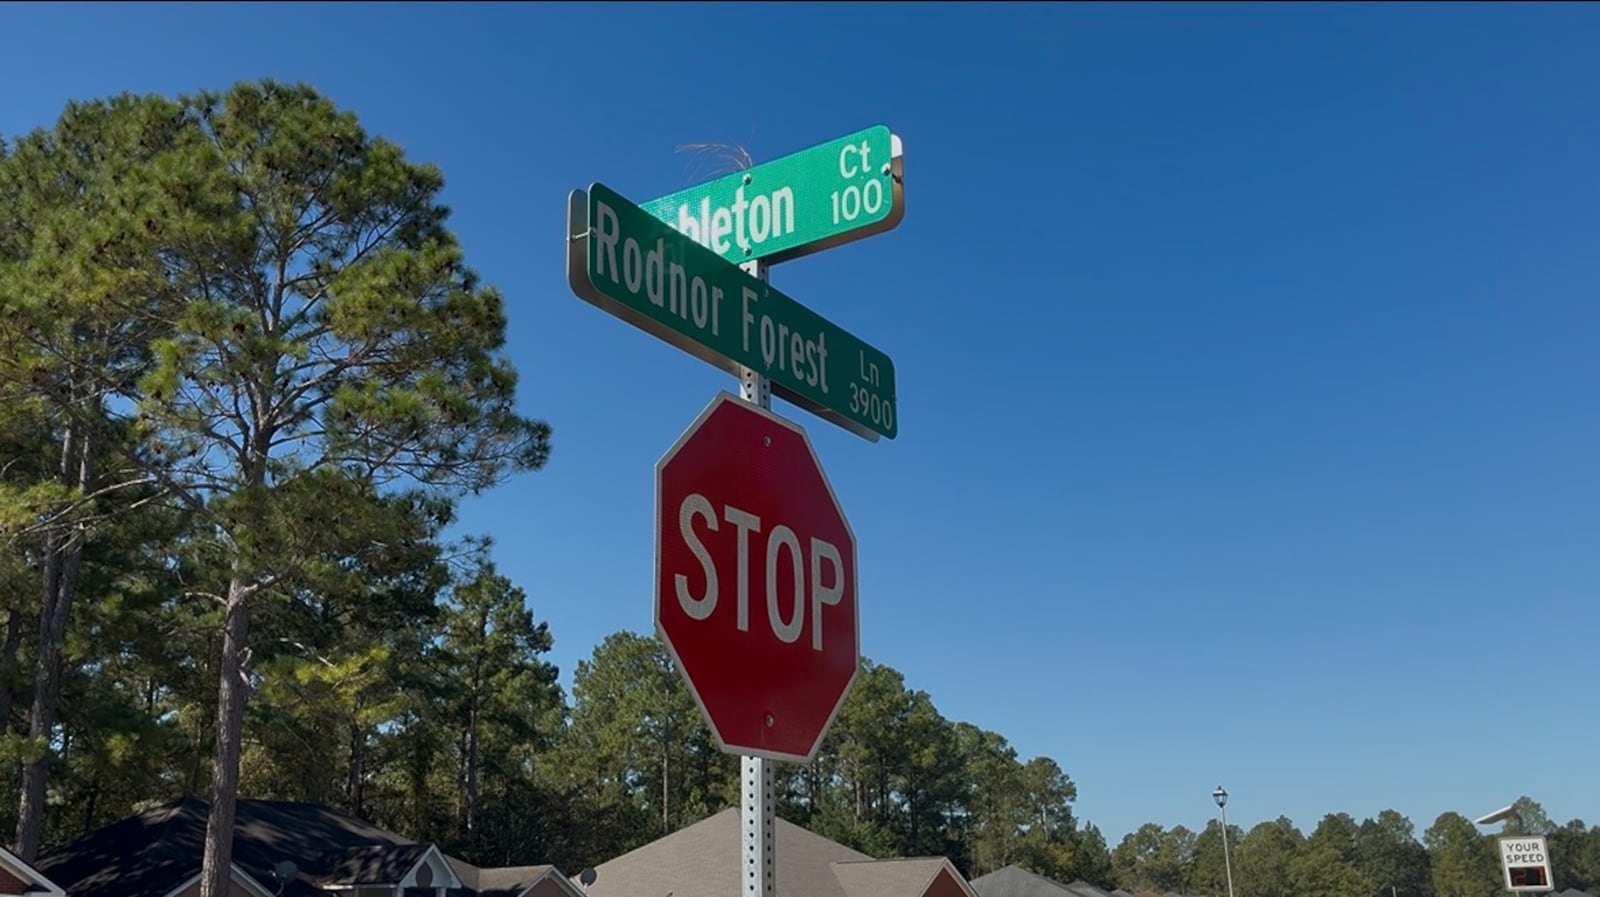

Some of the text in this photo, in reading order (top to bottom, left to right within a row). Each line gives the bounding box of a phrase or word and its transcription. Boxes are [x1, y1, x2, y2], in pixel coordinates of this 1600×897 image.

[669, 140, 871, 254] bleton Ct
[831, 178, 882, 224] 100
[597, 200, 879, 394] Rodnor Forest Ln
[849, 382, 893, 430] 3900
[675, 493, 845, 651] STOP
[1505, 853, 1544, 863] SPEED
[1507, 842, 1540, 852] YOUR
